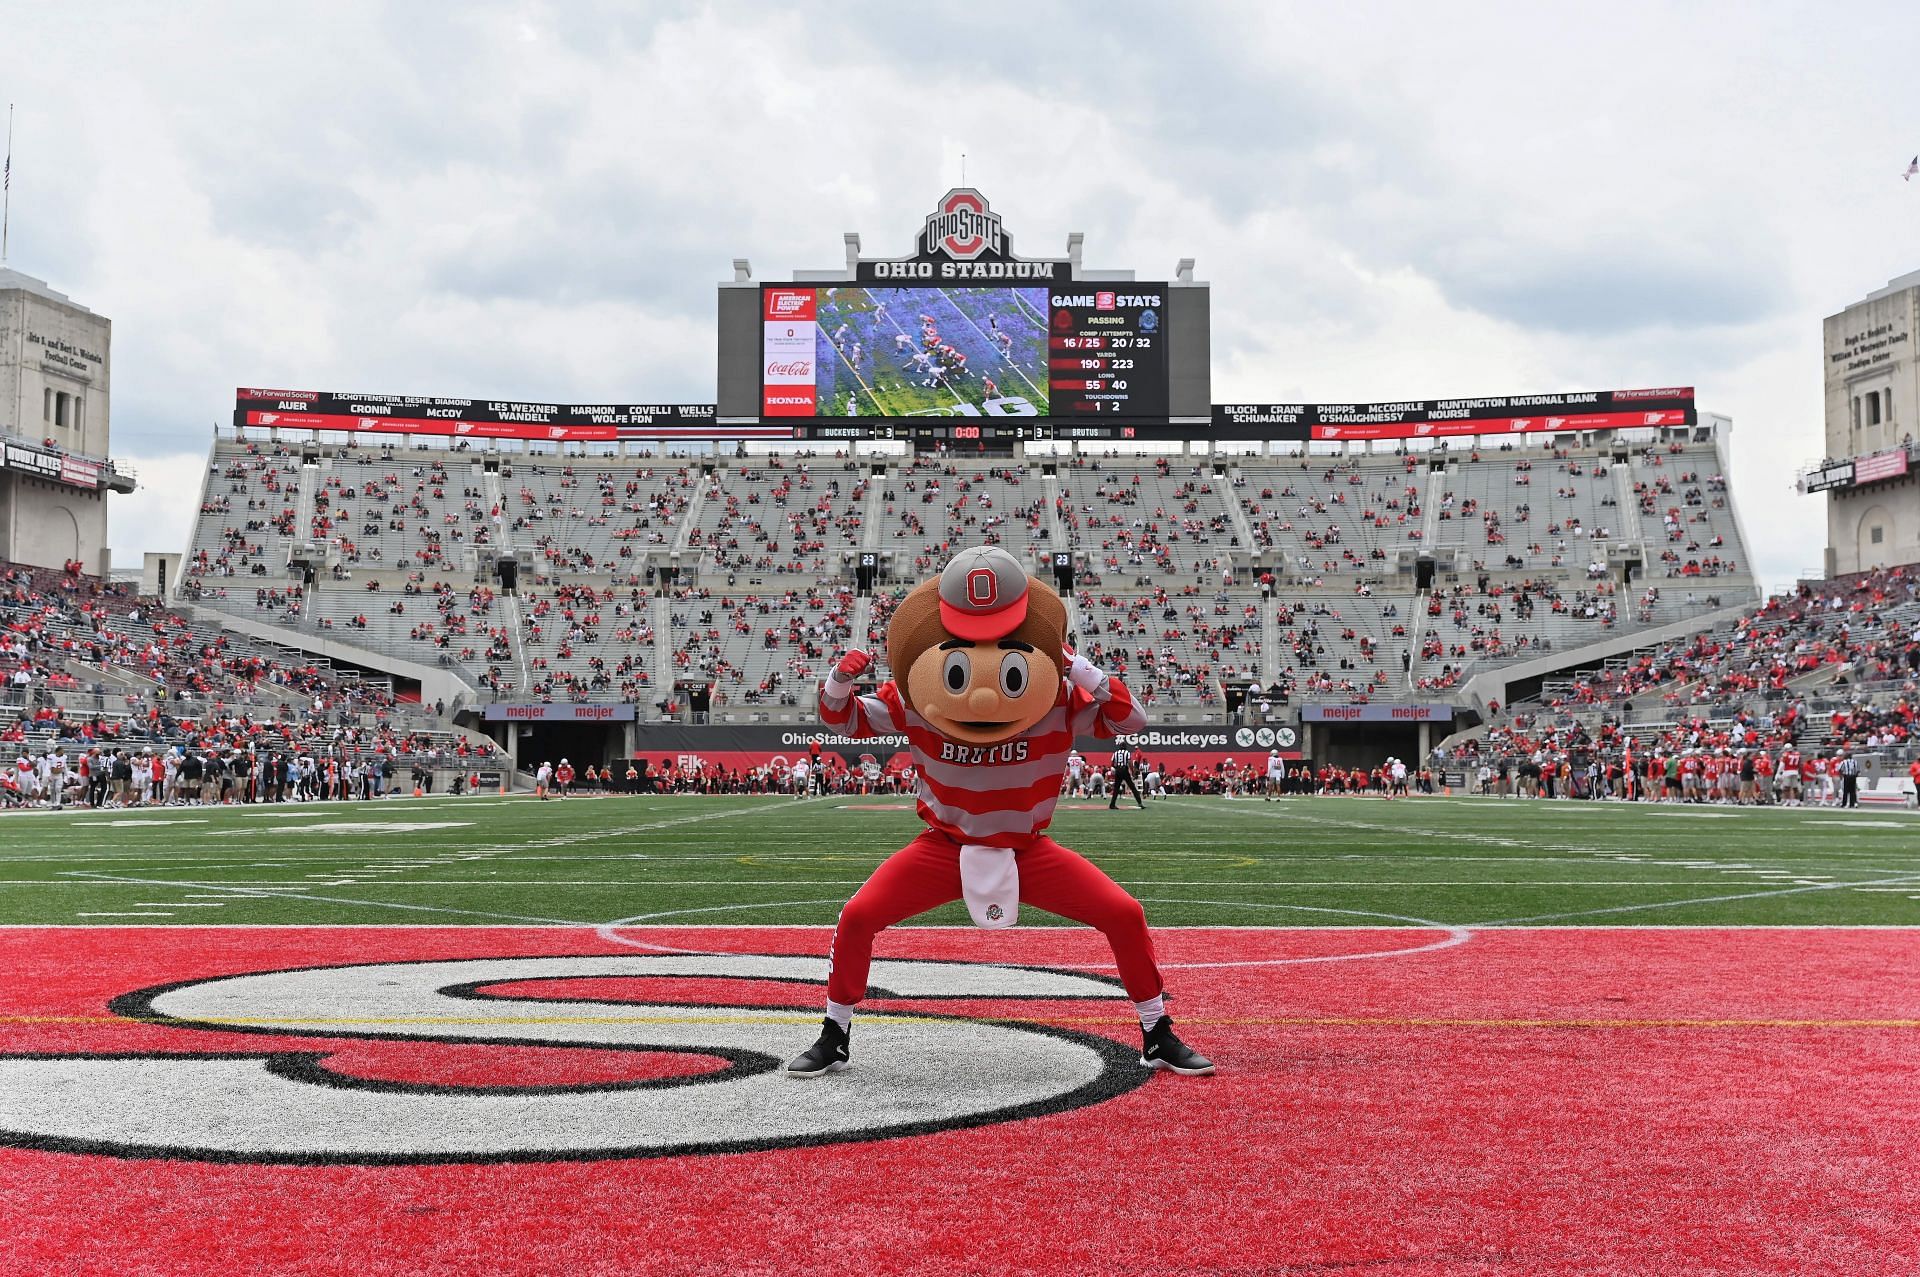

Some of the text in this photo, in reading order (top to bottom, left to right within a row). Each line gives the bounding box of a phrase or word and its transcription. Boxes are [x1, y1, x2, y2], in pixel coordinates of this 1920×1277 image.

[929, 208, 1000, 252] OHIO STATE
[874, 262, 1054, 279] OHIO STADIUM
[1051, 295, 1095, 307] GAME
[1116, 295, 1161, 307] STATS
[1087, 317, 1125, 325] PASSING
[1063, 338, 1101, 348] 16 / 25
[1111, 338, 1151, 348] 20 / 32
[1080, 359, 1101, 369] 190
[1111, 359, 1134, 369] 223
[1085, 380, 1101, 390] 55
[1111, 380, 1127, 390] 40
[250, 389, 316, 400] Pay Forward Society
[1614, 391, 1627, 399] Pay
[1627, 389, 1654, 397] Forward
[278, 401, 308, 410] AUER
[434, 398, 472, 407] DIAMOND
[766, 397, 814, 405] HONDA
[1094, 401, 1101, 411] 1
[1112, 401, 1120, 411] 2
[1437, 393, 1598, 410] HUNTINGTON NATIONAL BANK
[350, 404, 391, 415] CRONIN
[488, 402, 558, 415] LES WEXNER
[570, 406, 616, 415] HARMON
[629, 406, 671, 415] COVELLI
[678, 406, 714, 415] WELLS
[1224, 406, 1258, 414] BLOCH
[1270, 406, 1304, 414] CRANE
[1317, 405, 1356, 414] PHIPPS
[1368, 402, 1424, 413] McCORKLE
[426, 408, 463, 418] McCOY
[498, 411, 551, 422] WANDELL
[1319, 412, 1404, 423] O'SHAUGHNESSY
[1428, 408, 1470, 419] NOURSE
[591, 414, 653, 424] WOLFE FDN
[1232, 414, 1297, 423] SCHUMAKER
[824, 428, 860, 437] BUCKEYES
[886, 427, 892, 438] 3
[955, 427, 979, 438] 0:00
[1017, 427, 1023, 438] 3
[1036, 427, 1043, 438] 3
[1072, 428, 1099, 437] BRUTUS
[1124, 427, 1135, 438] 14
[862, 554, 874, 565] 23
[1056, 554, 1068, 565] 23
[966, 567, 998, 607] O
[506, 704, 545, 720] meijer
[575, 704, 614, 720] meijer
[1323, 704, 1362, 720] meijer
[1392, 704, 1430, 720] meijer
[1114, 731, 1228, 748] #GoBuckeyes
[940, 741, 1028, 764] BRUTUS
[1071, 758, 1080, 767] 35
